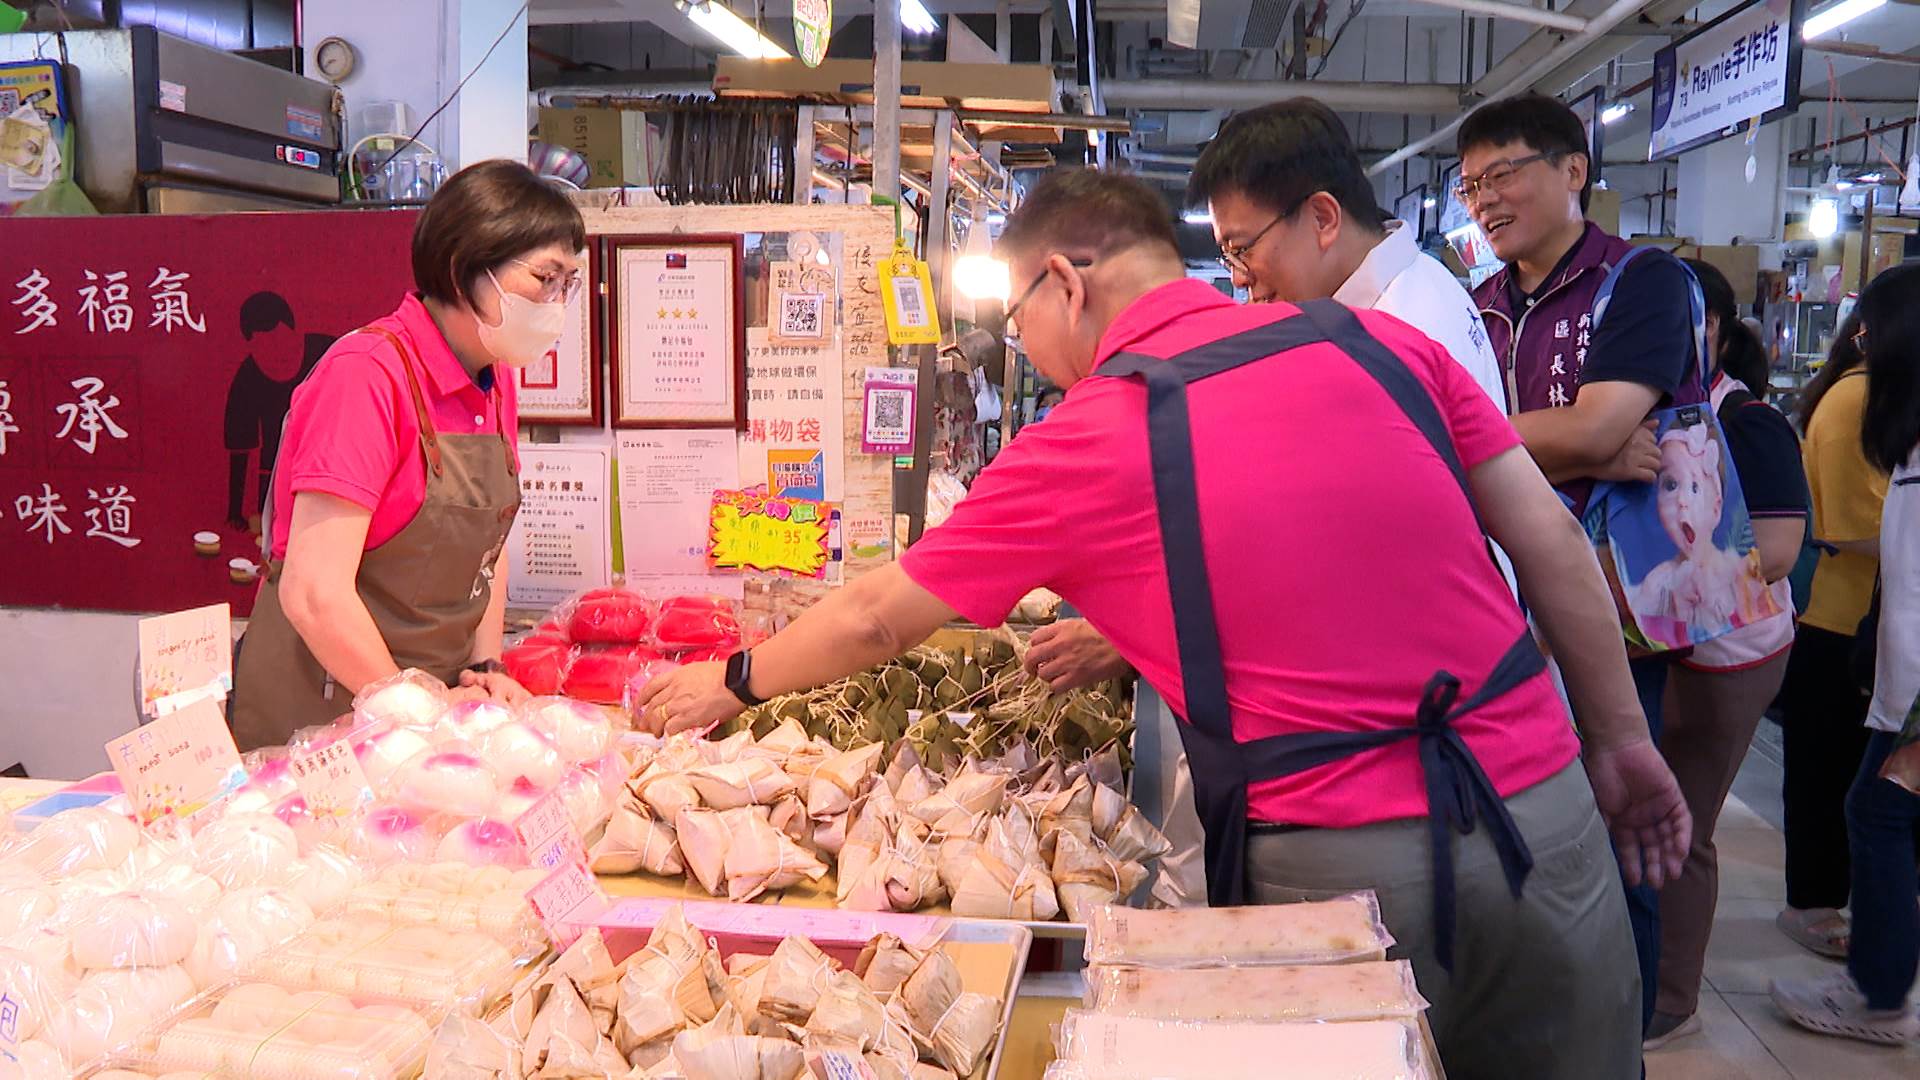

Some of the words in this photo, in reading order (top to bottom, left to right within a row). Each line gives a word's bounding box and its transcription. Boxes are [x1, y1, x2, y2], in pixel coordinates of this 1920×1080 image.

[1692, 20, 1779, 94] Raynie手作坊
[1680, 91, 1688, 108] 73
[11, 266, 206, 334] 多福氣
[1549, 318, 1571, 408] 區長林
[1573, 313, 1592, 385] 新北市
[744, 417, 821, 442] 購物袋
[0, 483, 142, 548] 味道
[784, 529, 801, 544] 35
